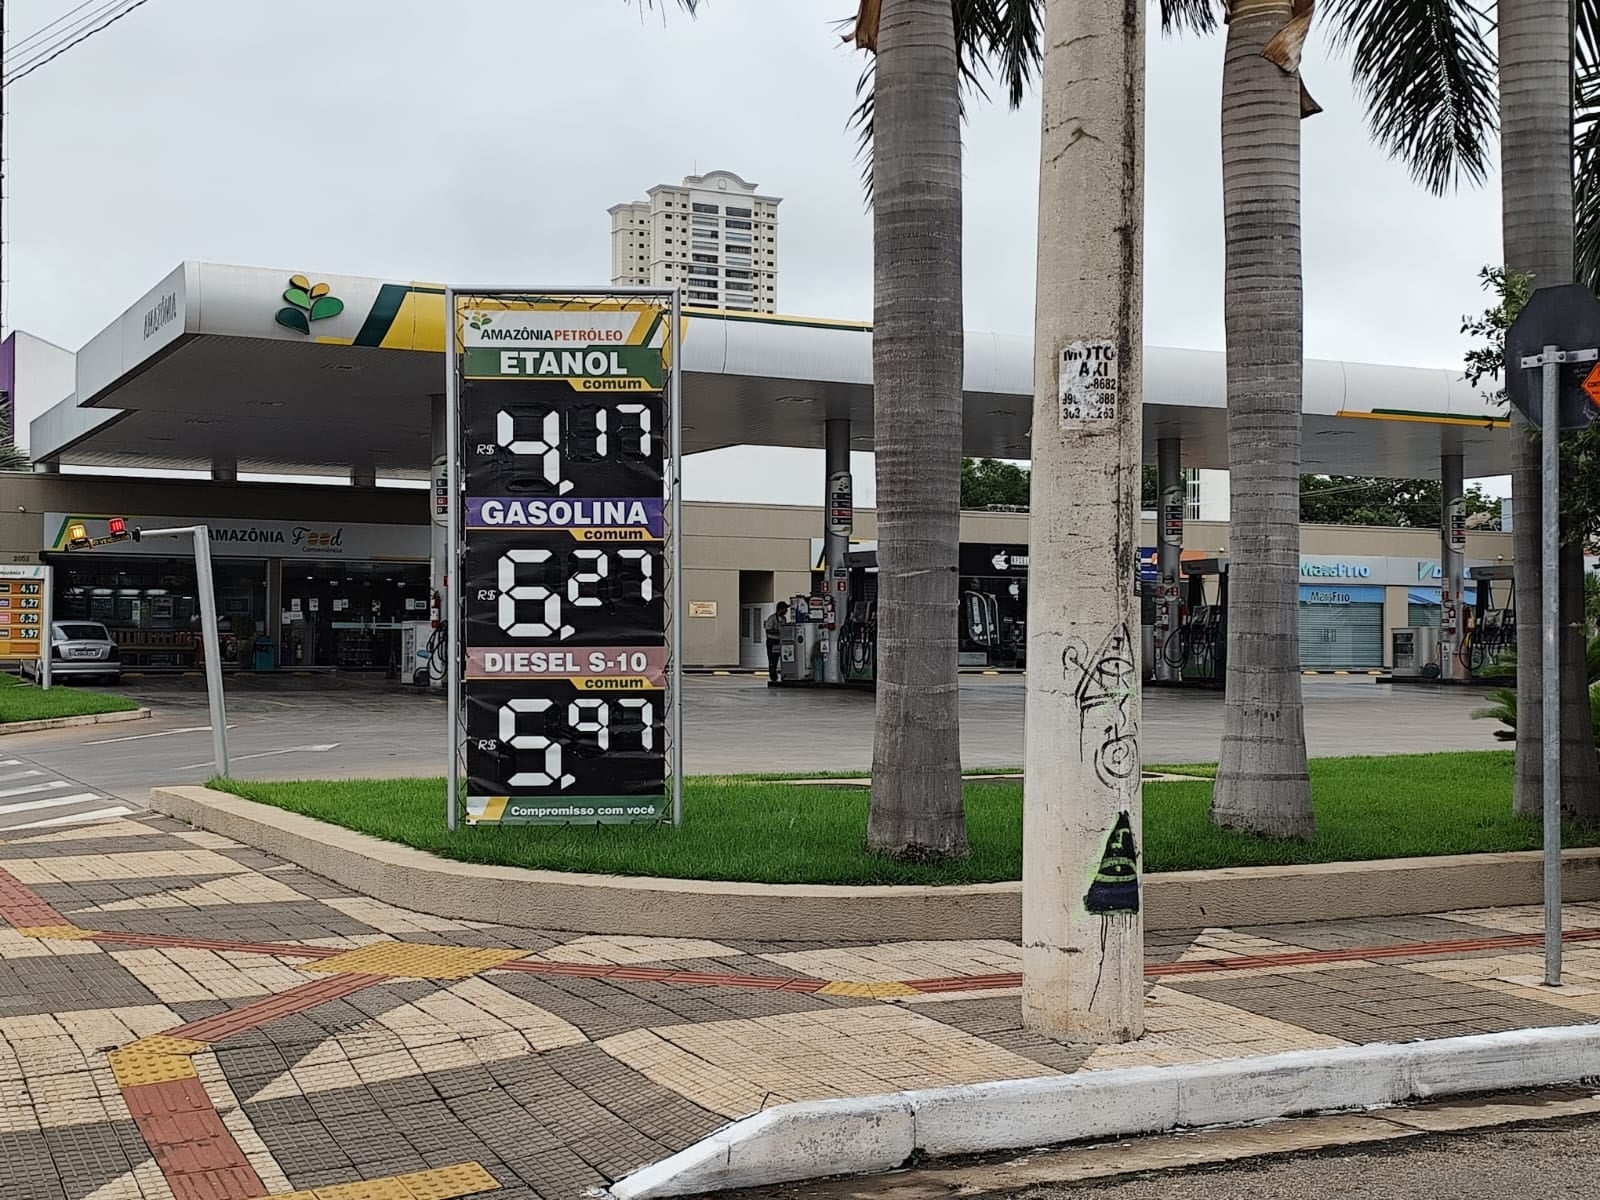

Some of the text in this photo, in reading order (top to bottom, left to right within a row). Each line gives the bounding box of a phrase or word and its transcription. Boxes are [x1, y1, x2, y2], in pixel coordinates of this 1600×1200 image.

[500, 351, 628, 376] ETANOL
[583, 379, 642, 390] comum
[476, 444, 495, 455] R$
[481, 501, 649, 526] GASOLINA
[207, 528, 285, 543] AMAZÔNIA
[584, 530, 643, 540] comum
[477, 590, 497, 601] R$
[484, 653, 648, 673] DIESEL S-10
[585, 677, 644, 689] comum
[478, 739, 497, 750] R$
[511, 806, 595, 818] Compromisso
[627, 804, 655, 815] você
